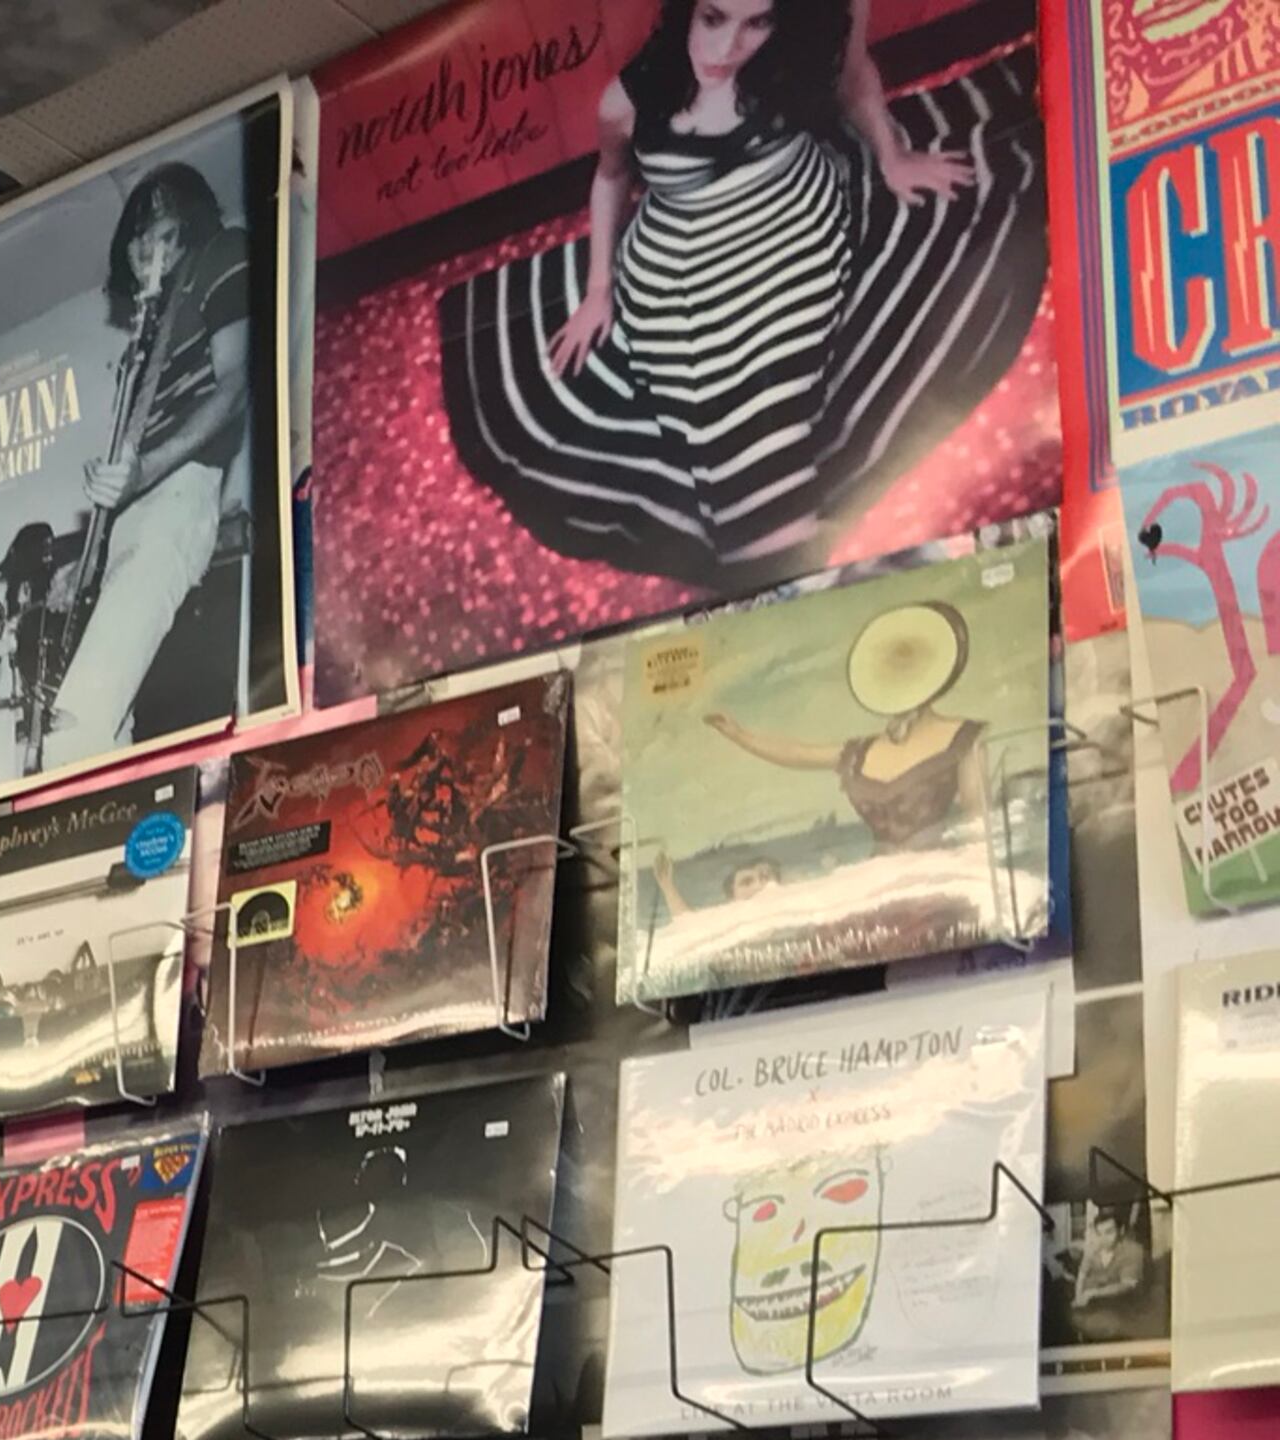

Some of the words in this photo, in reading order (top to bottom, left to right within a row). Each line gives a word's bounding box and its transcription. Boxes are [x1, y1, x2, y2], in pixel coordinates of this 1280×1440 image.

[336, 65, 472, 171] norah
[474, 20, 601, 140] jones
[67, 800, 140, 833] McGee
[1214, 798, 1259, 831] TOO
[694, 1062, 745, 1099] COL.
[754, 1044, 829, 1096] BRUCE
[838, 1026, 964, 1081] HAMPTON
[885, 1384, 954, 1404] ROOM
